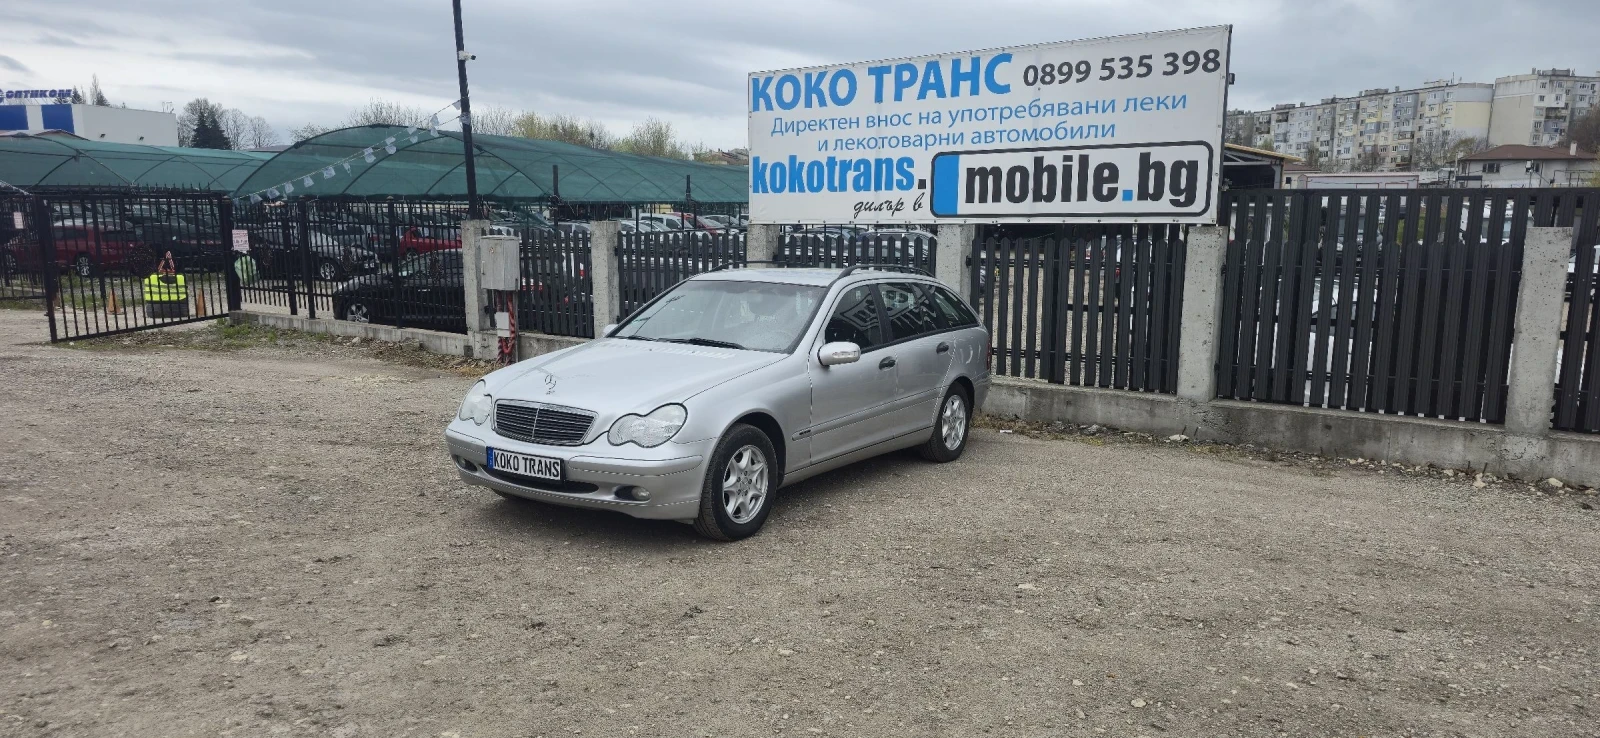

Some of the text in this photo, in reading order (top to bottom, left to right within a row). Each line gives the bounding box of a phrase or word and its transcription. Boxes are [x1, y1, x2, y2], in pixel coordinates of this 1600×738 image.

[752, 53, 1013, 112] КОКО ТРАНС
[1023, 49, 1221, 86] 0899 535 398
[771, 94, 1187, 136] Директен внос на употребявани леки
[818, 121, 1116, 151] и лекотоварни автомобили
[752, 152, 1200, 208] kokotrans. mobile.bg
[853, 191, 925, 218] дилър в
[494, 451, 560, 477] KOKO TRANS
